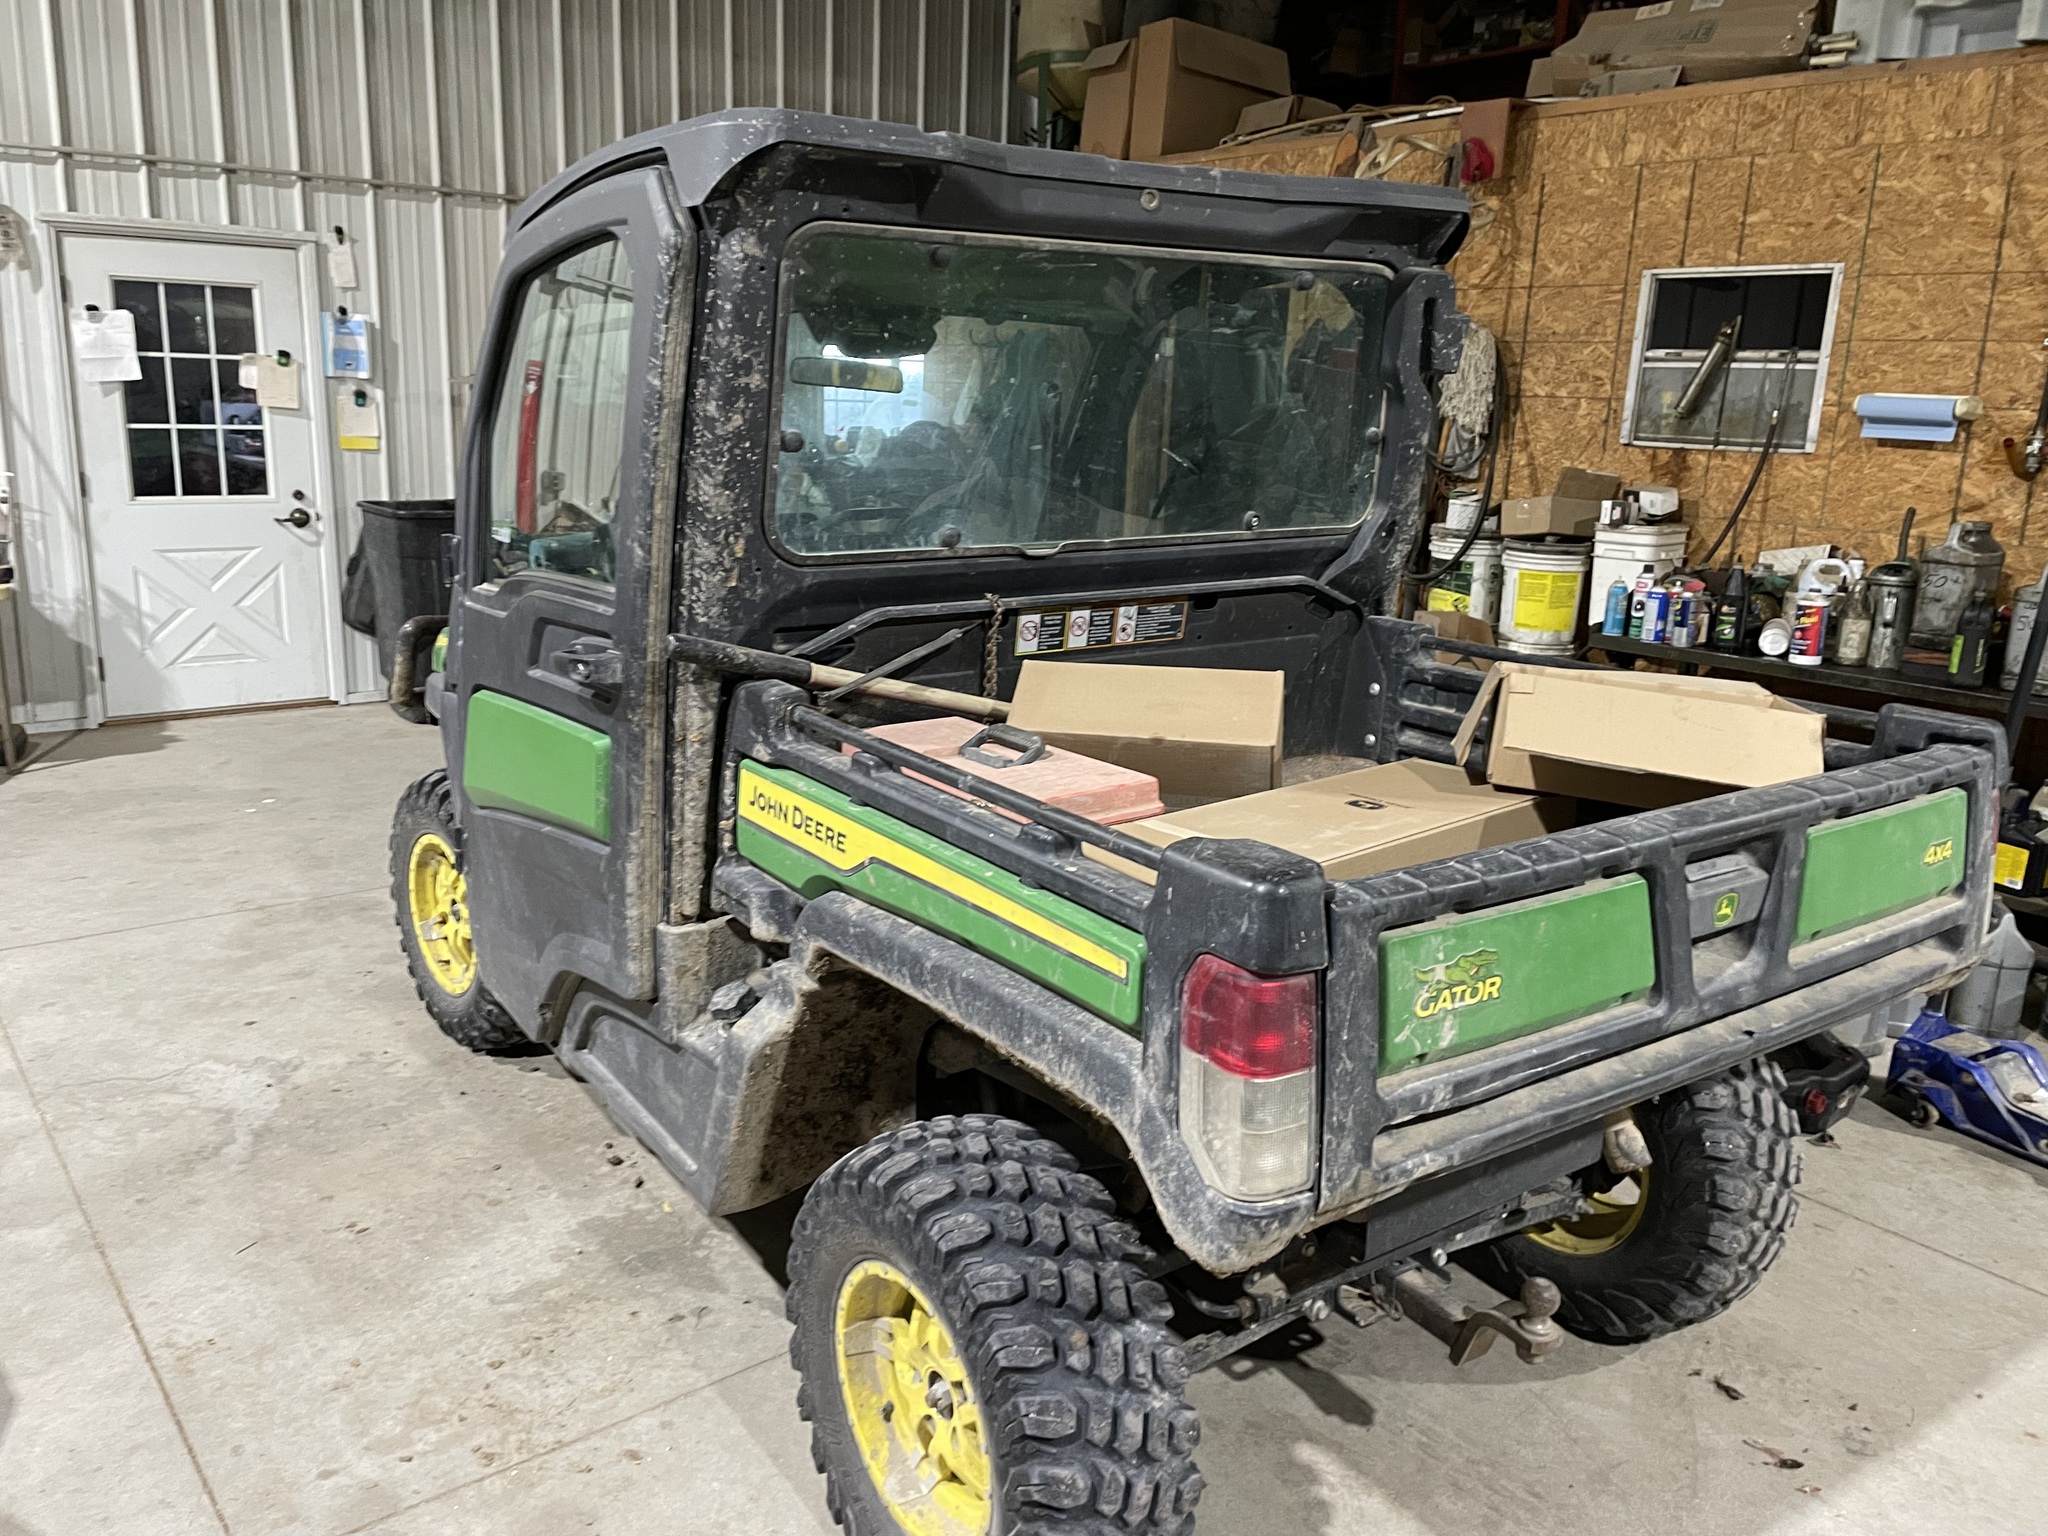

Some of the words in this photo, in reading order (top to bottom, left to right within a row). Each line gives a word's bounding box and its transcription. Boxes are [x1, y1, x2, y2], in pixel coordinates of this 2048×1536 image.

[749, 785, 789, 824] JOHN
[792, 805, 847, 854] DEERE
[1414, 975, 1503, 1018] GATOR
